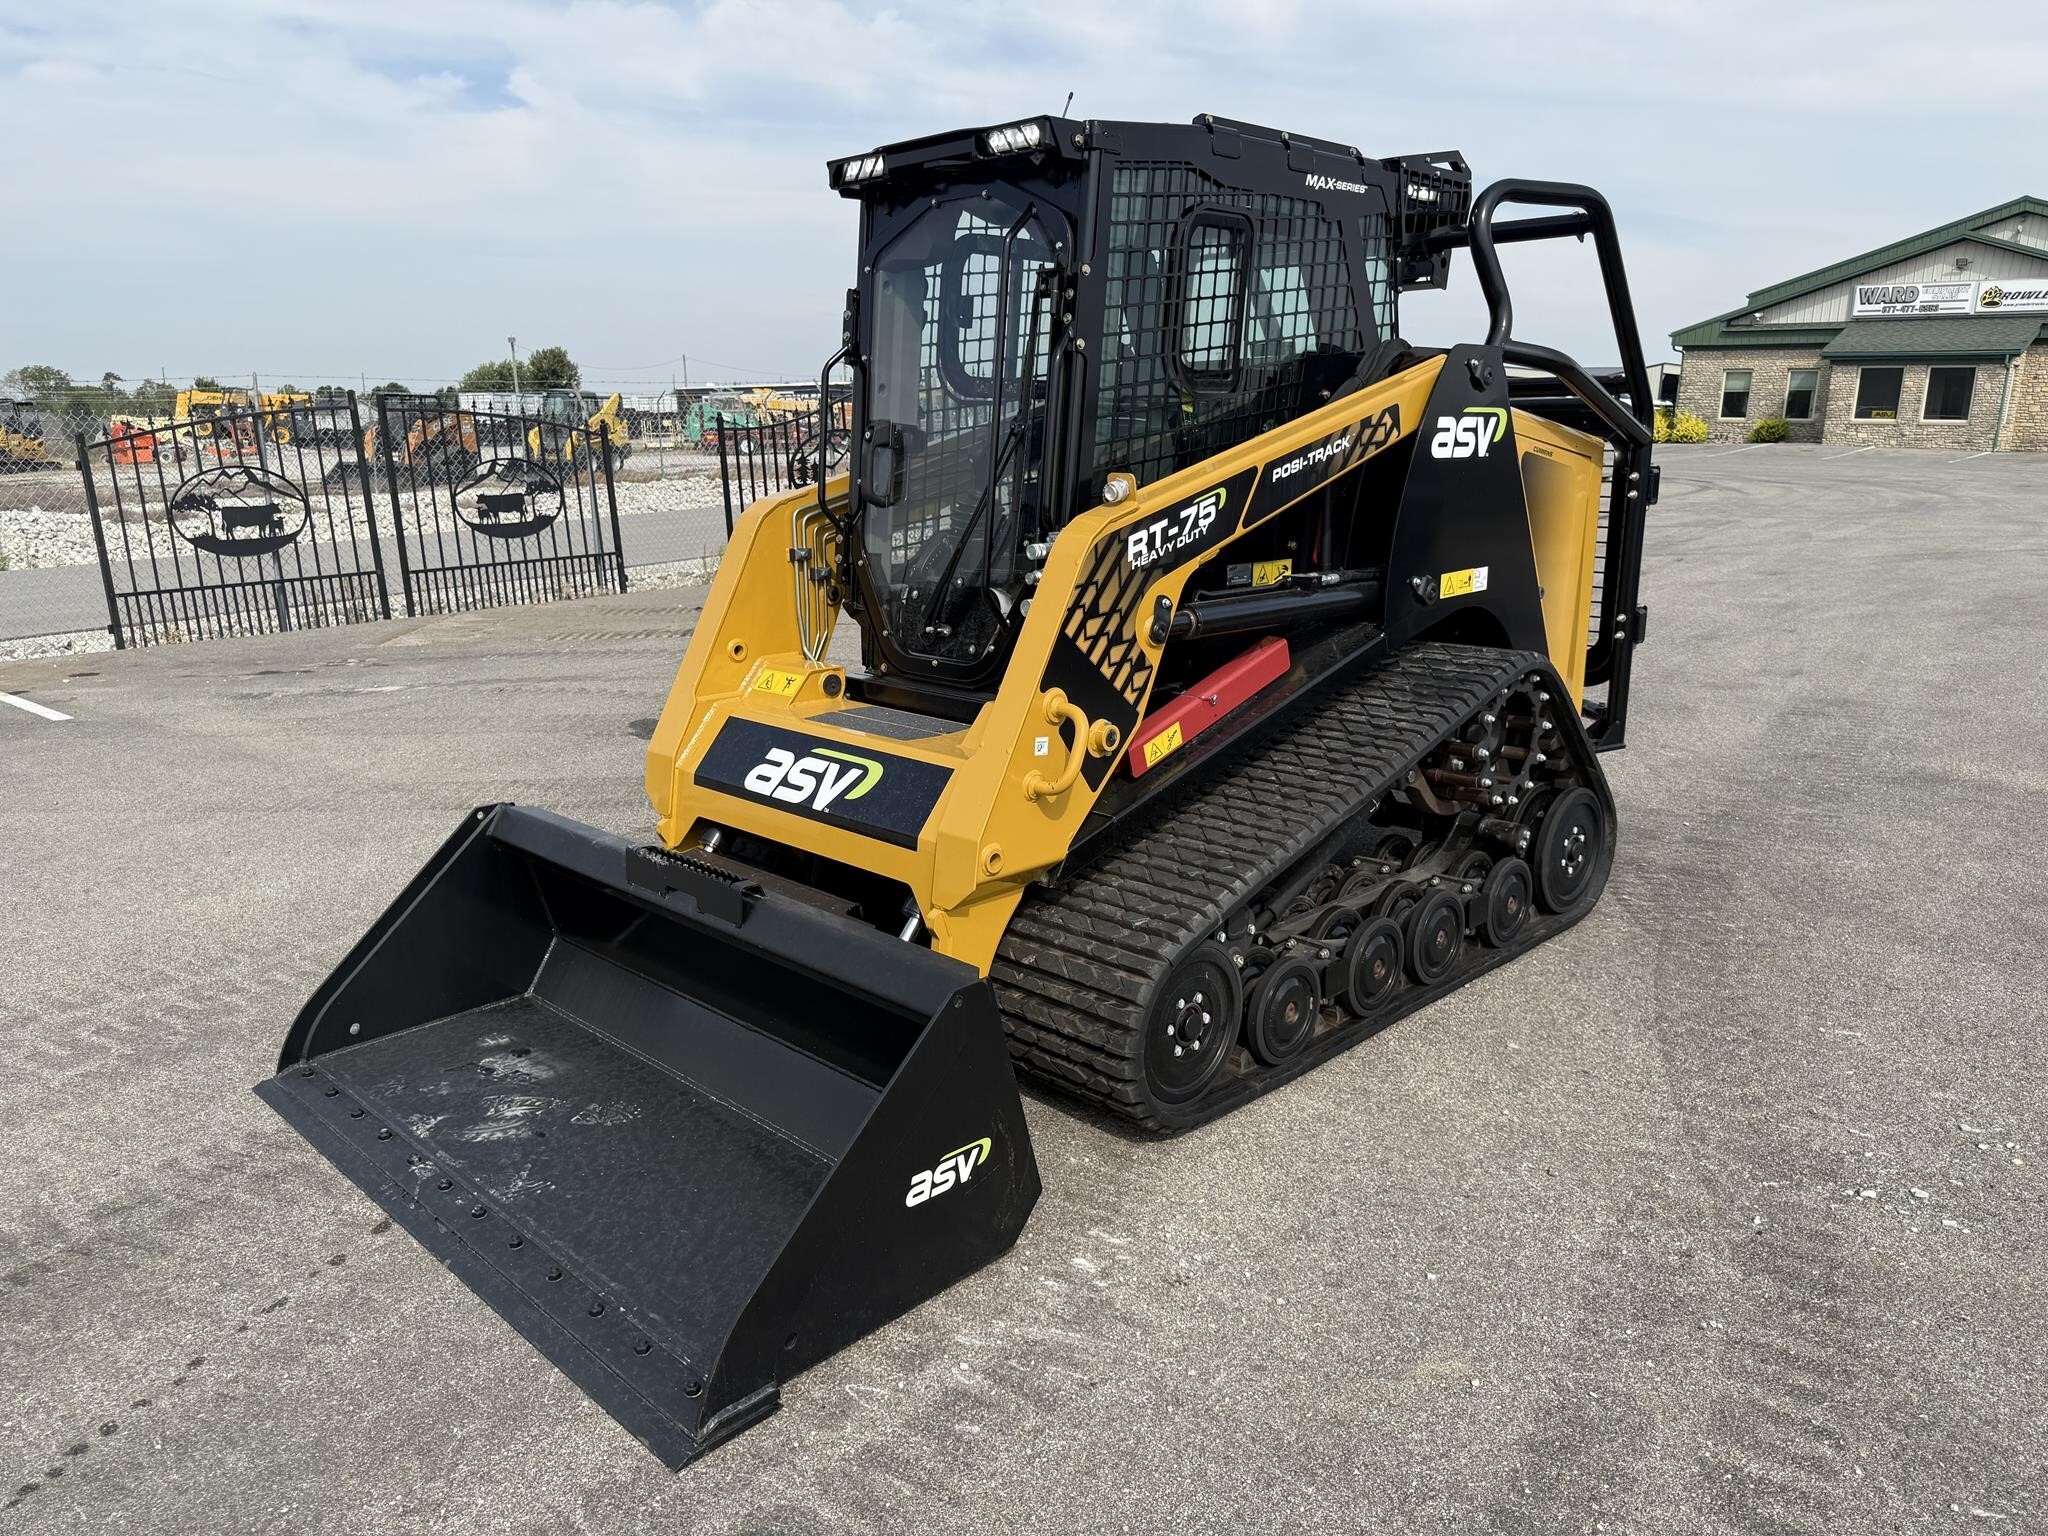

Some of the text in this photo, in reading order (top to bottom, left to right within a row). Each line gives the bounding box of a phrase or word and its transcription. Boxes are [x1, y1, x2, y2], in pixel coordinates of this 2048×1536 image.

[1305, 173, 1367, 194] MAX-SERIES
[1858, 286, 1920, 305] WARD
[1272, 435, 1350, 483] POSI-TRACK
[1127, 495, 1217, 563] RT-75
[1131, 523, 1210, 571] HEAVY DUTY
